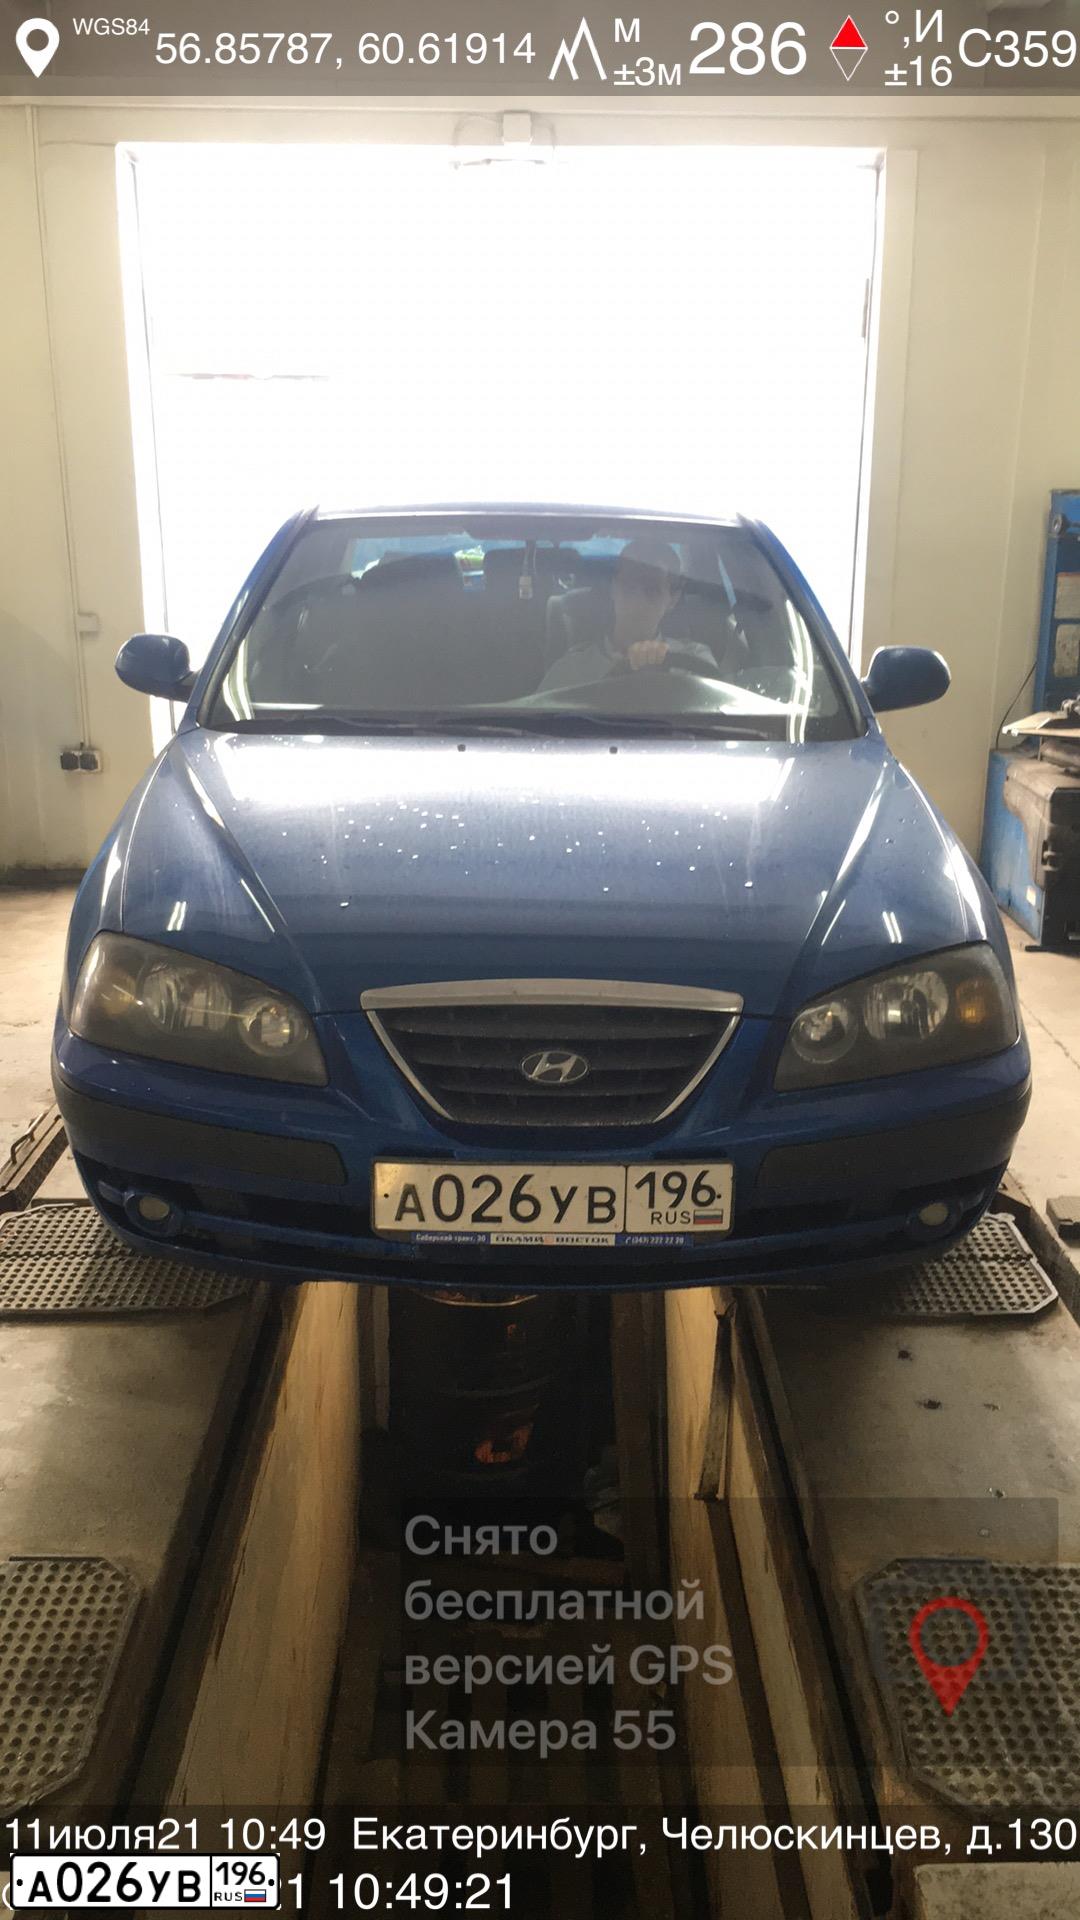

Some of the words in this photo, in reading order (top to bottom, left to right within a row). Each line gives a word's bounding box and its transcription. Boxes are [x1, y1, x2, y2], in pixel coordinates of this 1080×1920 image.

[394, 1173, 617, 1224] А026УВ
[634, 1170, 716, 1209] 196
[650, 1211, 692, 1225] RUS
